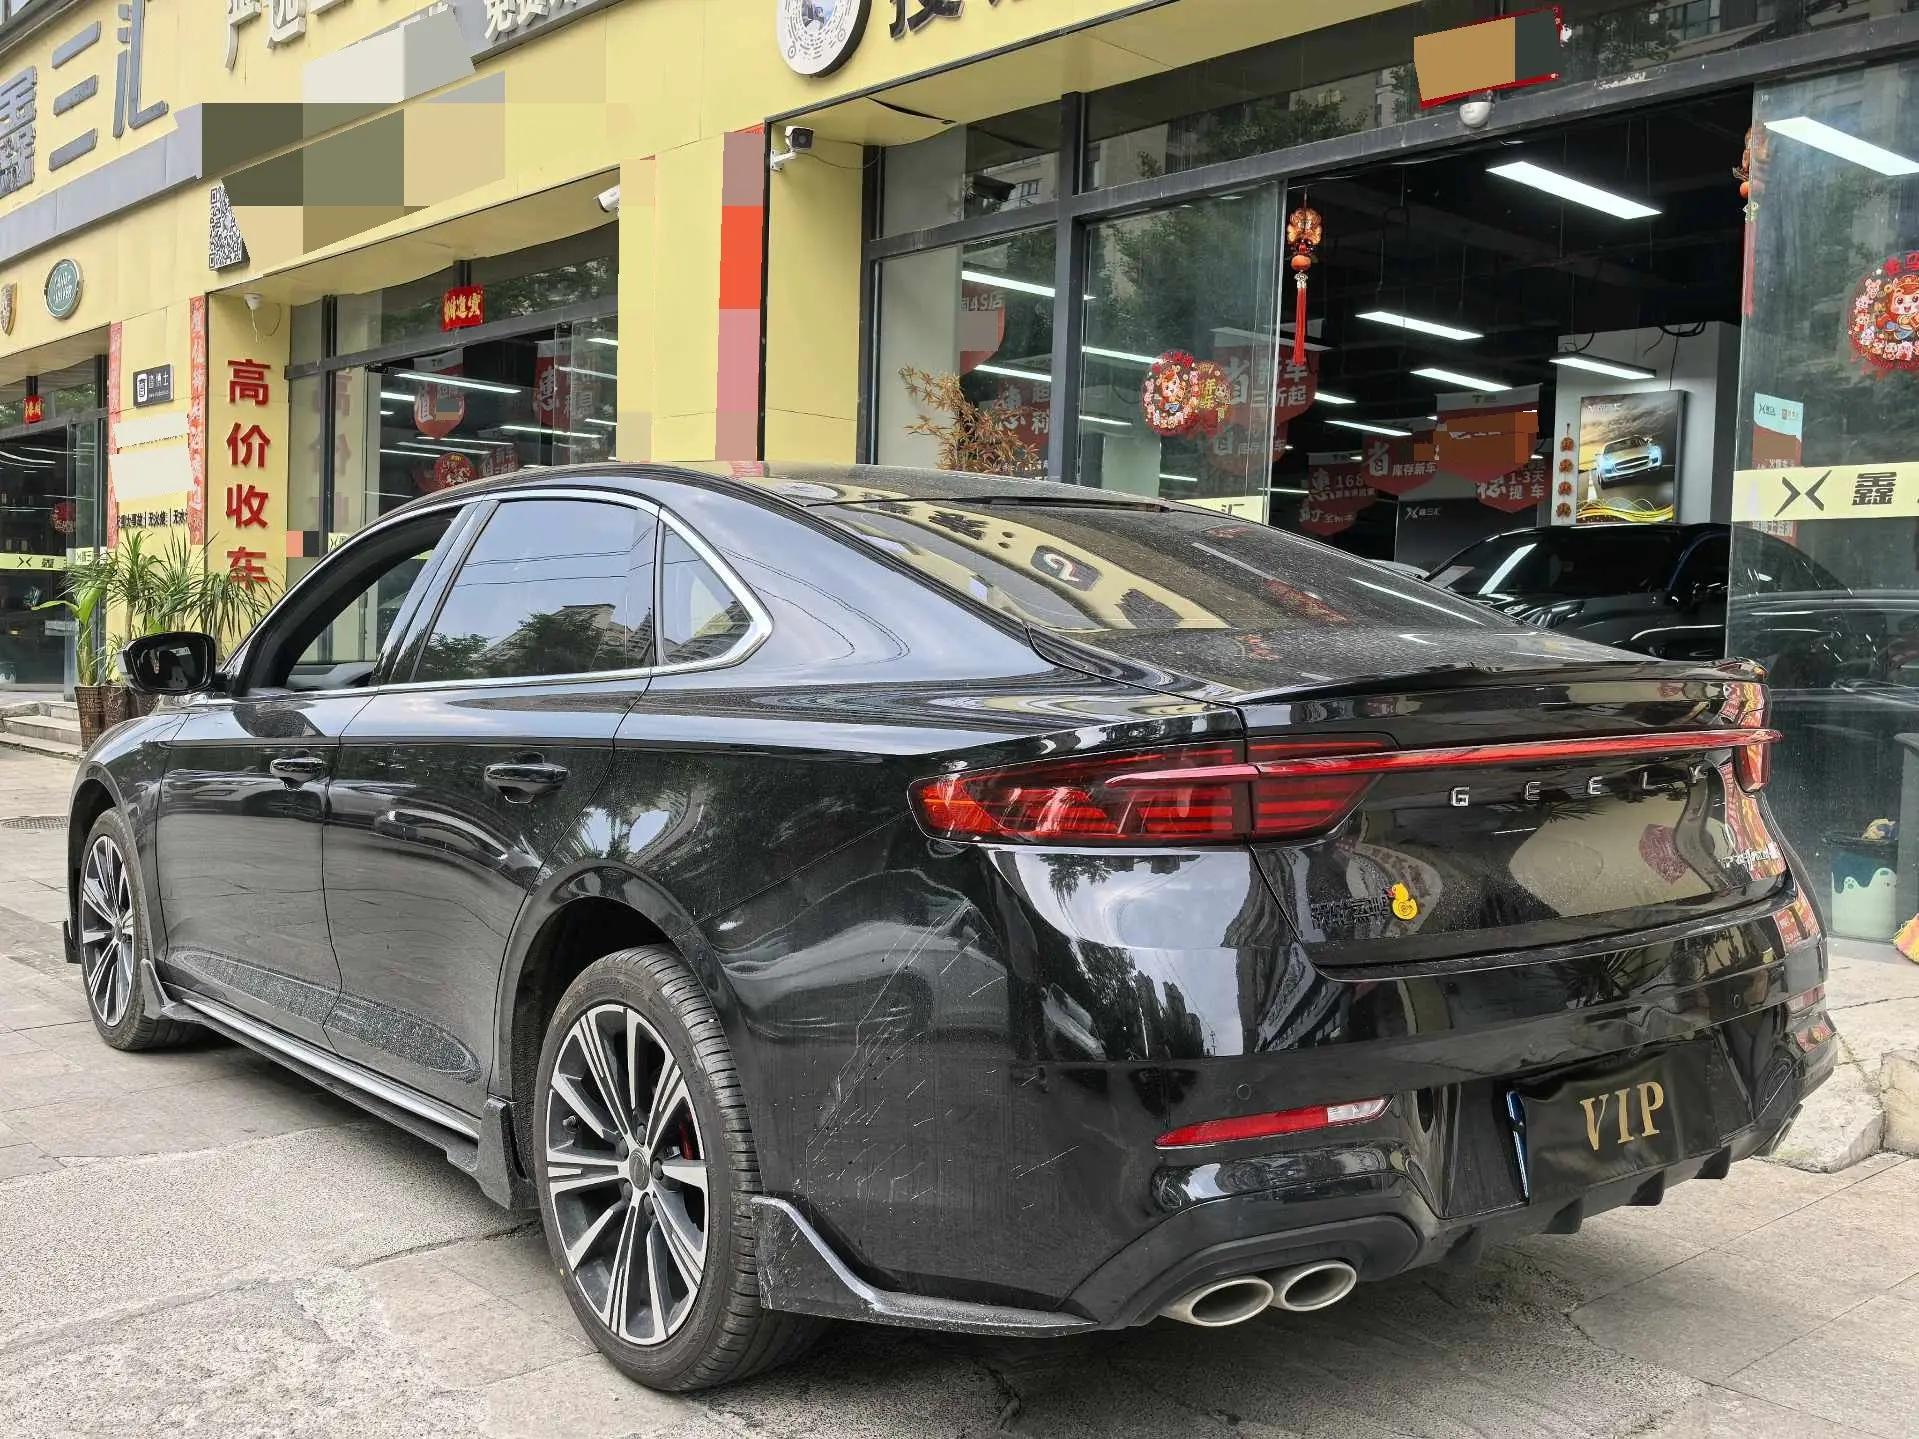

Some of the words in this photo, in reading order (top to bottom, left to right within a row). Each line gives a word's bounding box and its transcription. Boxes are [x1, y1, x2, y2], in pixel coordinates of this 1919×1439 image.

[226, 358, 271, 589] 高价收车
[1851, 471, 1919, 506] 鑫
[1450, 764, 1705, 807] GEELY
[1579, 1081, 1664, 1151] VIP
